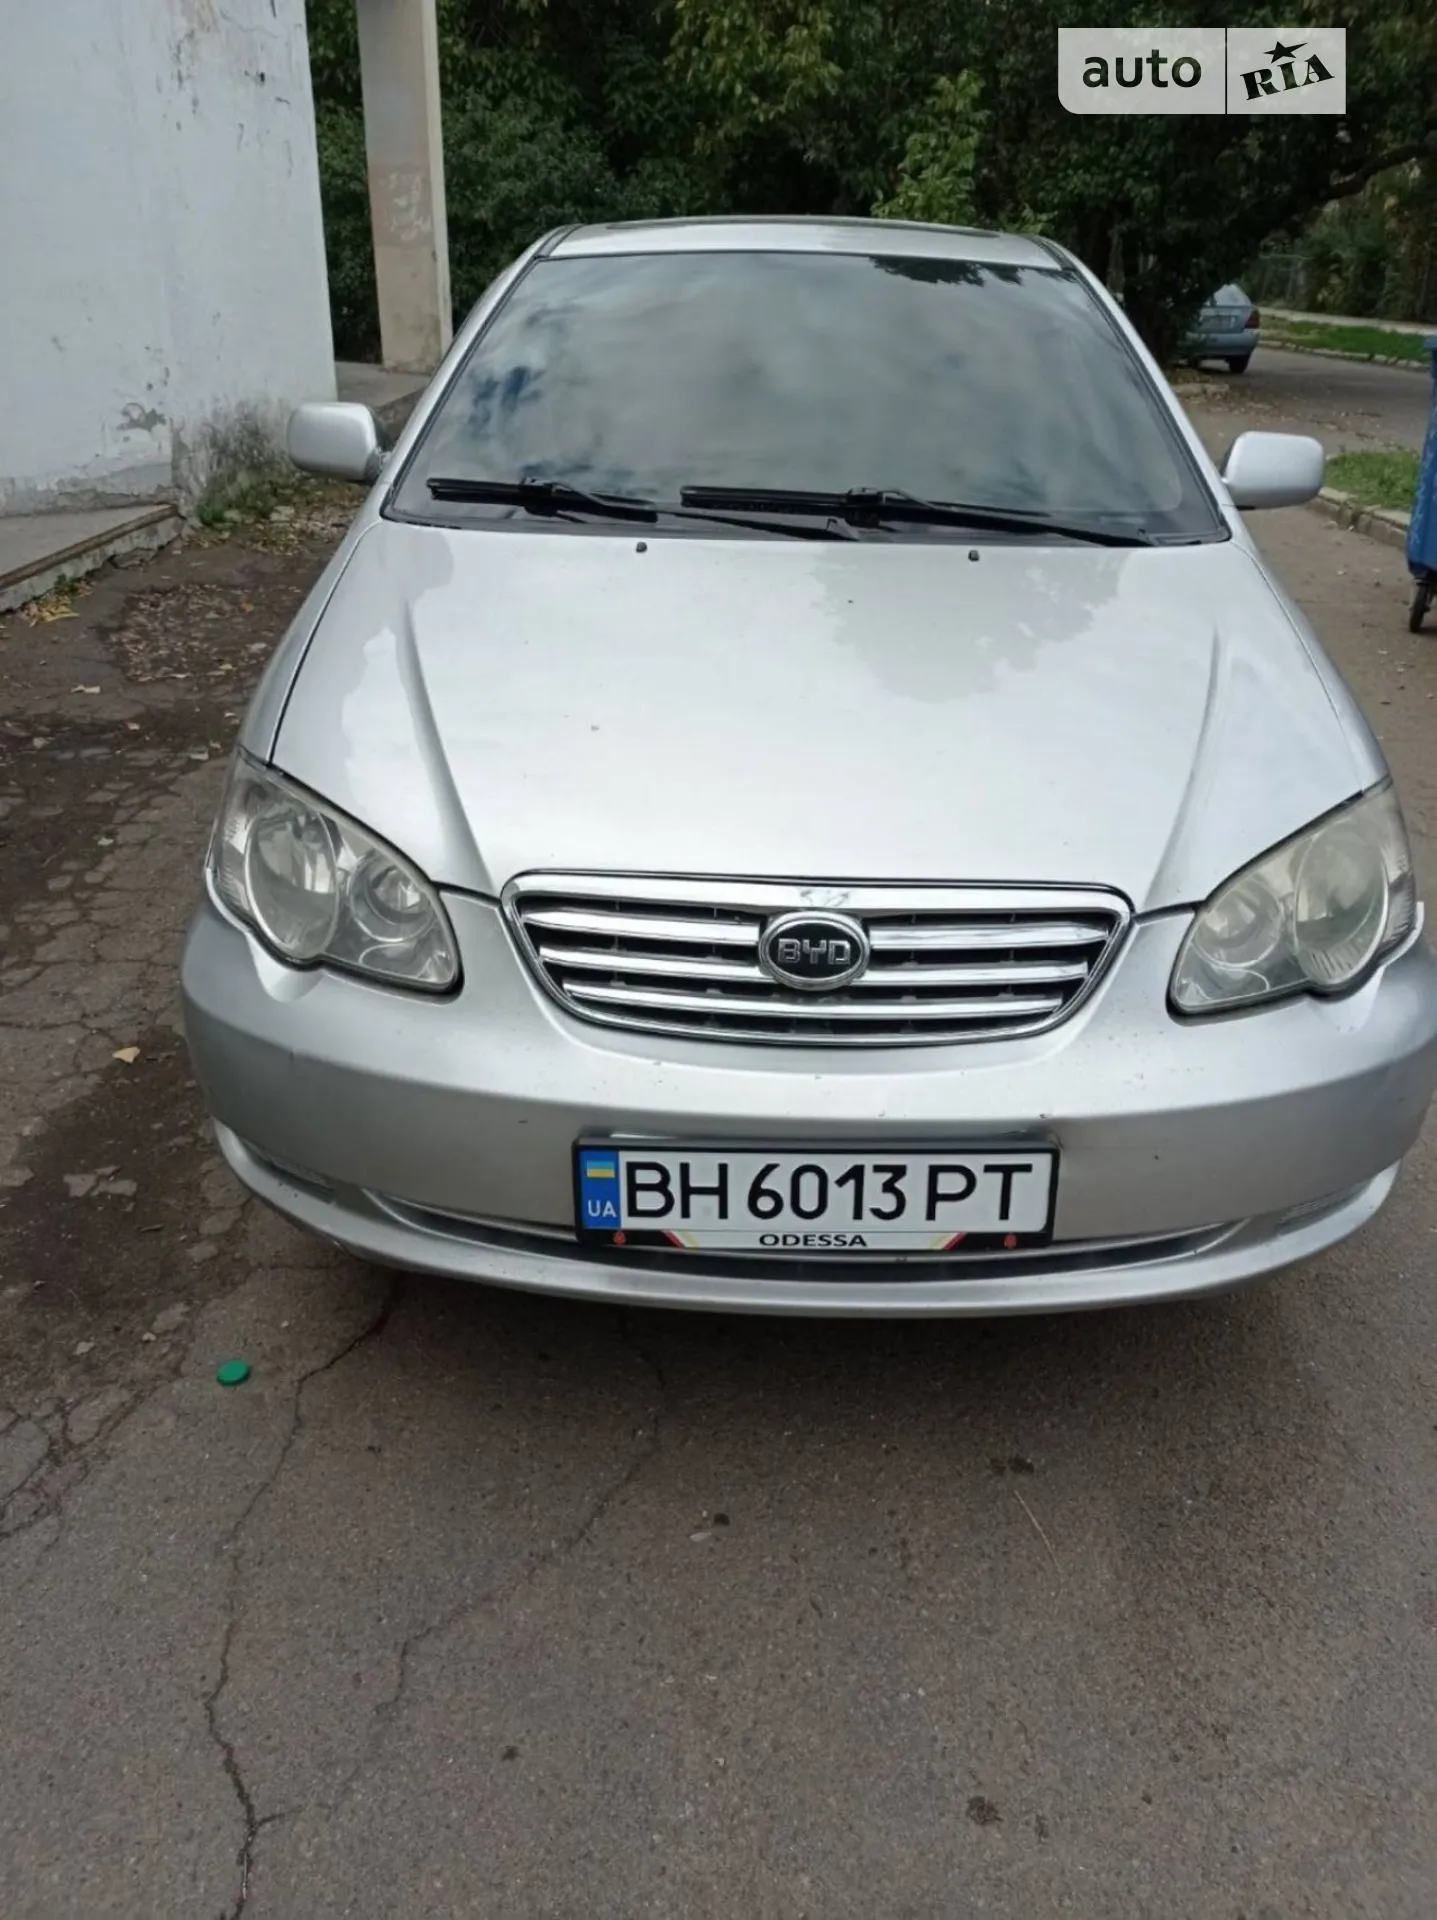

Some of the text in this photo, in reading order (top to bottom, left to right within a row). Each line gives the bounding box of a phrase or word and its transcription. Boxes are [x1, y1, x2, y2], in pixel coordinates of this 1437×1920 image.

[778, 938, 851, 965] BYD
[626, 1162, 1033, 1221] BH 6013 PT
[587, 1200, 617, 1218] UA
[759, 1234, 868, 1247] ODESSA
